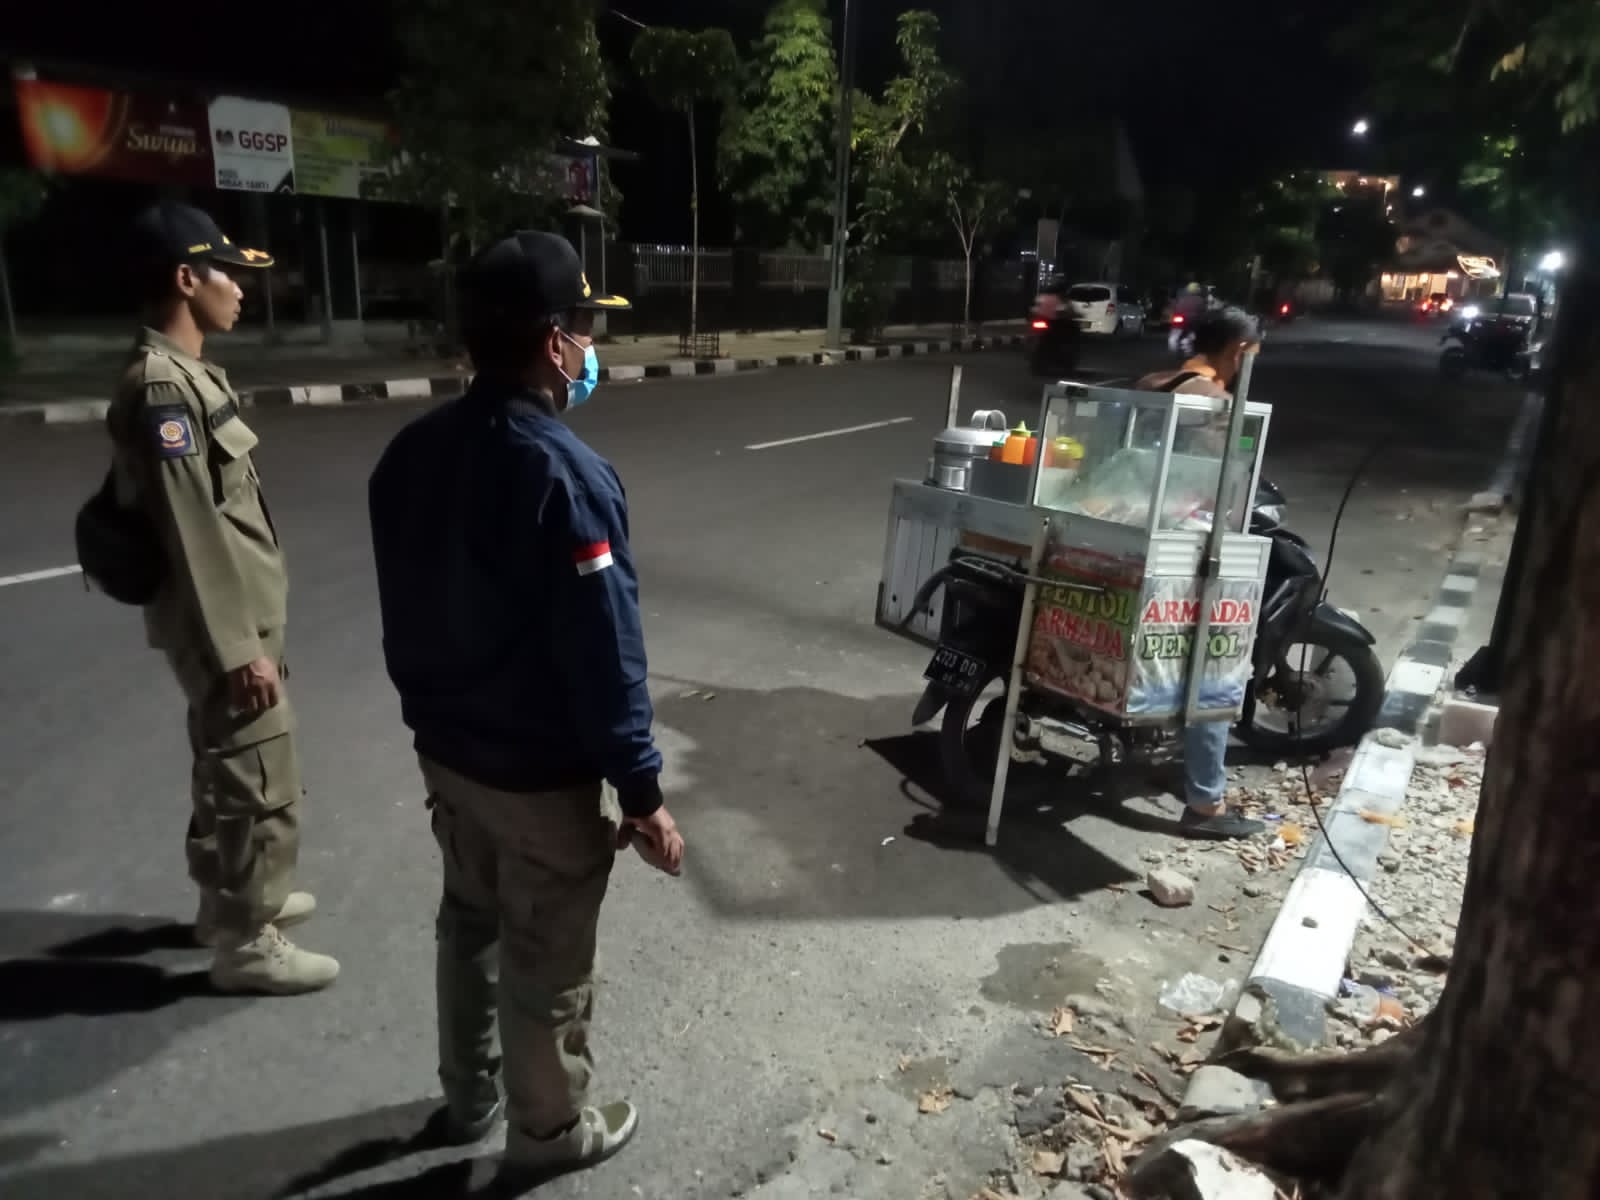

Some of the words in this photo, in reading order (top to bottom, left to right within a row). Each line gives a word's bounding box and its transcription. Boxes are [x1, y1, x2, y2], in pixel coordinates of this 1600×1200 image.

[238, 131, 288, 153] GGSP
[1036, 603, 1125, 659] ARMADA
[1143, 632, 1240, 659] PENOL
